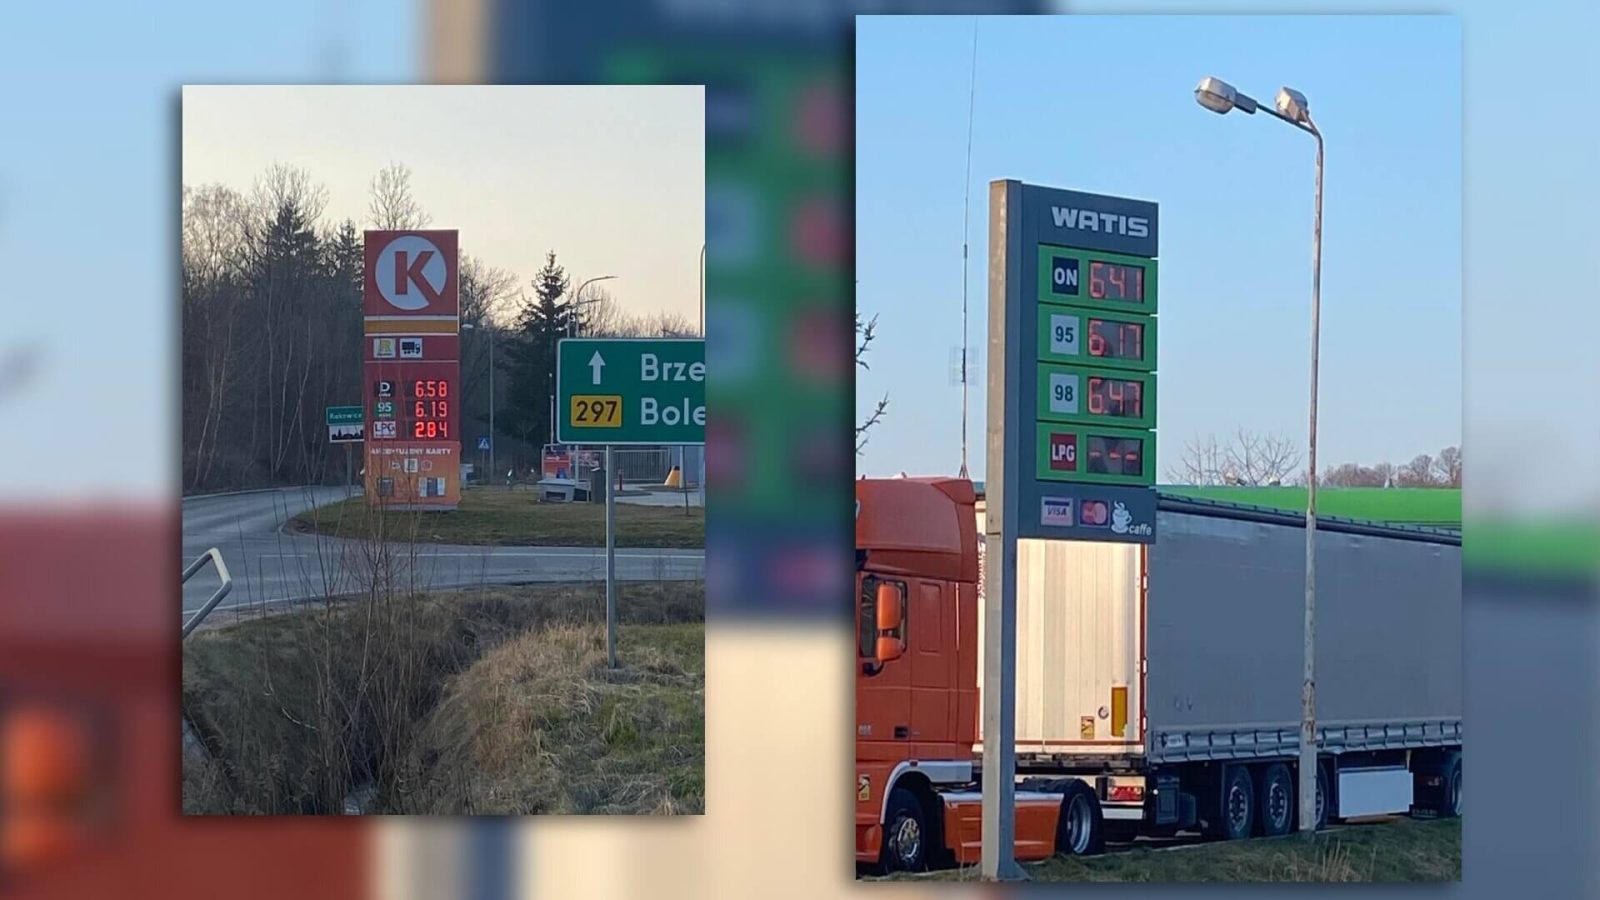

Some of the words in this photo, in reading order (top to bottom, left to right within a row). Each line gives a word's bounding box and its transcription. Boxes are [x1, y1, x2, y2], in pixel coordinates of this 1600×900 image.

[1051, 206, 1148, 238] WATIS
[395, 251, 440, 304] K
[1054, 268, 1078, 286] ON
[1055, 326, 1074, 343] 95
[641, 353, 705, 381] Brze
[380, 382, 390, 392] D
[415, 381, 448, 397] 6.58
[1054, 384, 1073, 402] 98
[377, 402, 392, 412] 95
[415, 401, 448, 418] 6.19
[576, 401, 617, 422] 297
[641, 397, 705, 426] Bole
[375, 423, 395, 432] LPG
[415, 421, 448, 438] 2.84
[1052, 443, 1075, 462] LPG
[1047, 505, 1067, 517] VISA
[1128, 522, 1152, 536] caffe
